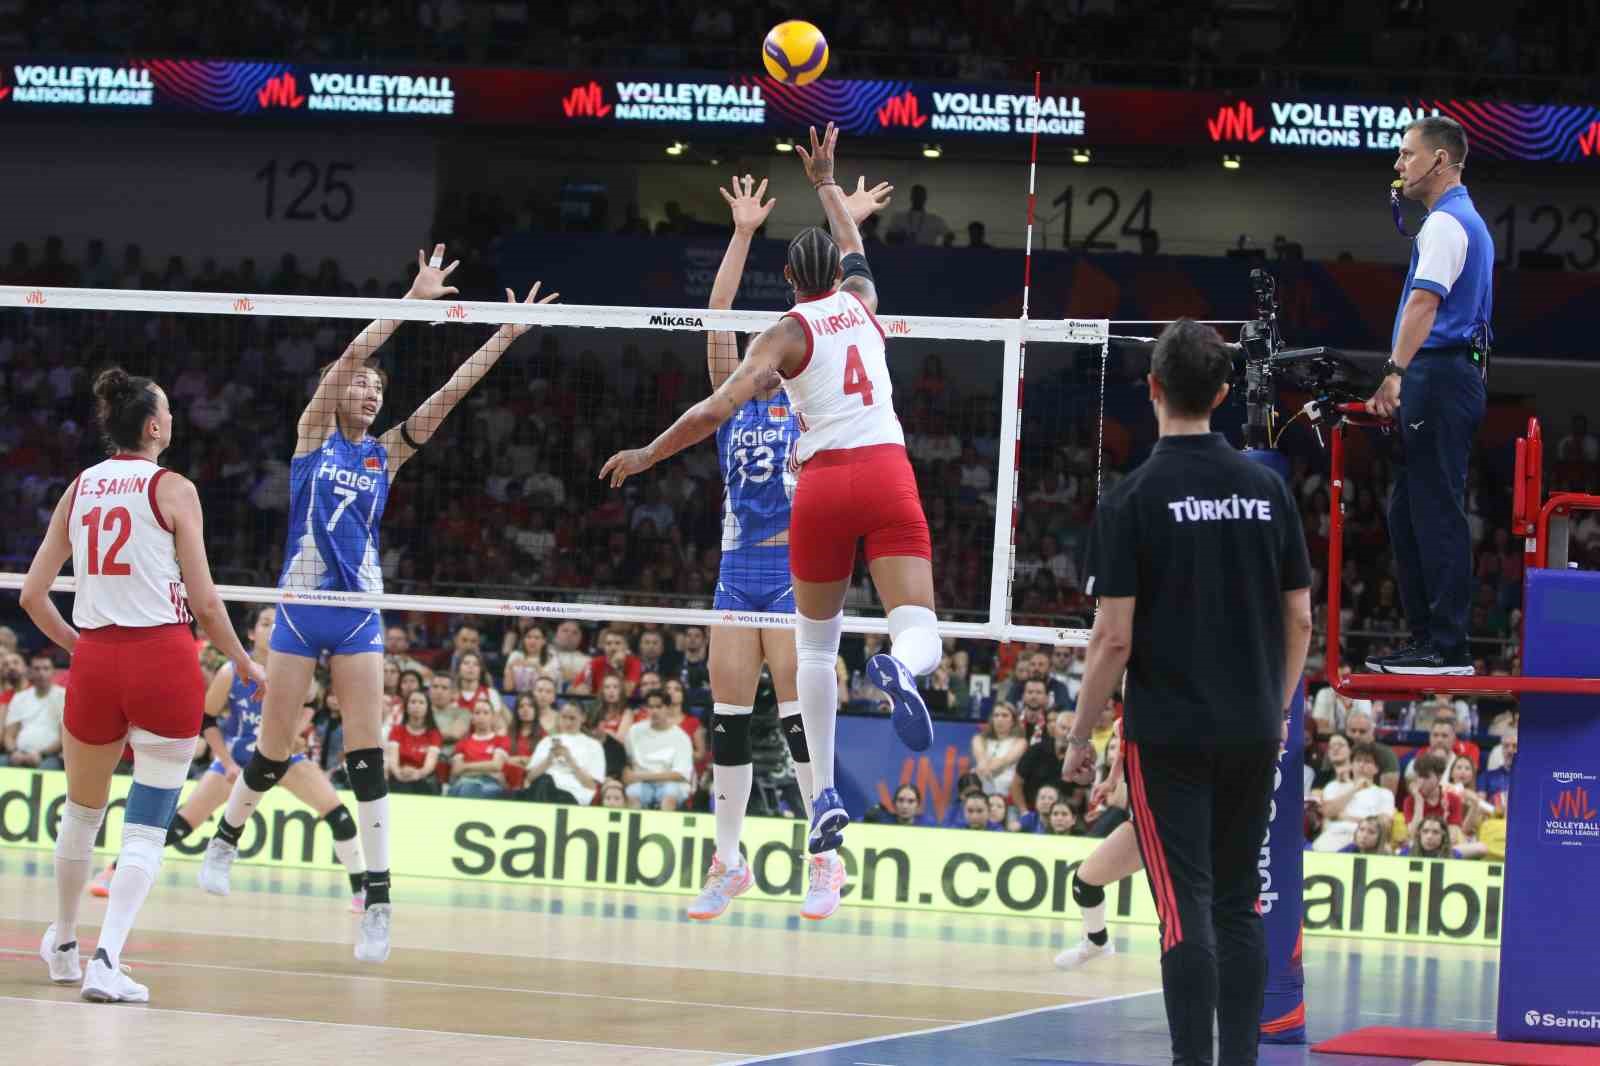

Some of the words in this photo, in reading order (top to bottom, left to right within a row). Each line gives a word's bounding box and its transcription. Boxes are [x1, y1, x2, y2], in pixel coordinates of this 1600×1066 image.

[14, 65, 154, 89] VOLLEYBALL
[310, 73, 455, 97] VOLLEYBALL
[12, 86, 85, 103] NATIONS
[88, 89, 153, 105] LEAGUE
[308, 95, 384, 112] NATIONS
[387, 98, 454, 114] LEAGUE
[616, 82, 766, 106] VOLLEYBALL
[932, 92, 1085, 117] VOLLEYBALL
[615, 104, 693, 121] NATIONS
[697, 107, 765, 123] LEAGUE
[931, 115, 1010, 132] NATIONS
[1015, 118, 1084, 135] LEAGUE
[1208, 101, 1265, 142] VNL
[1270, 127, 1360, 147] NATIONS
[1367, 131, 1403, 149] LEA
[255, 159, 356, 222] 125
[1053, 186, 1155, 249] 124
[1494, 204, 1599, 271] 123
[843, 344, 873, 406] 4
[731, 426, 785, 446] Haier
[319, 462, 377, 493] Haier
[734, 445, 775, 488] 13
[327, 486, 358, 532] 7
[1168, 493, 1272, 522] TÜRKİYE
[82, 506, 131, 576] 12
[877, 745, 970, 822] VN
[1545, 828, 1573, 836] NATIONS
[1546, 820, 1598, 831] VOLLEYBALL
